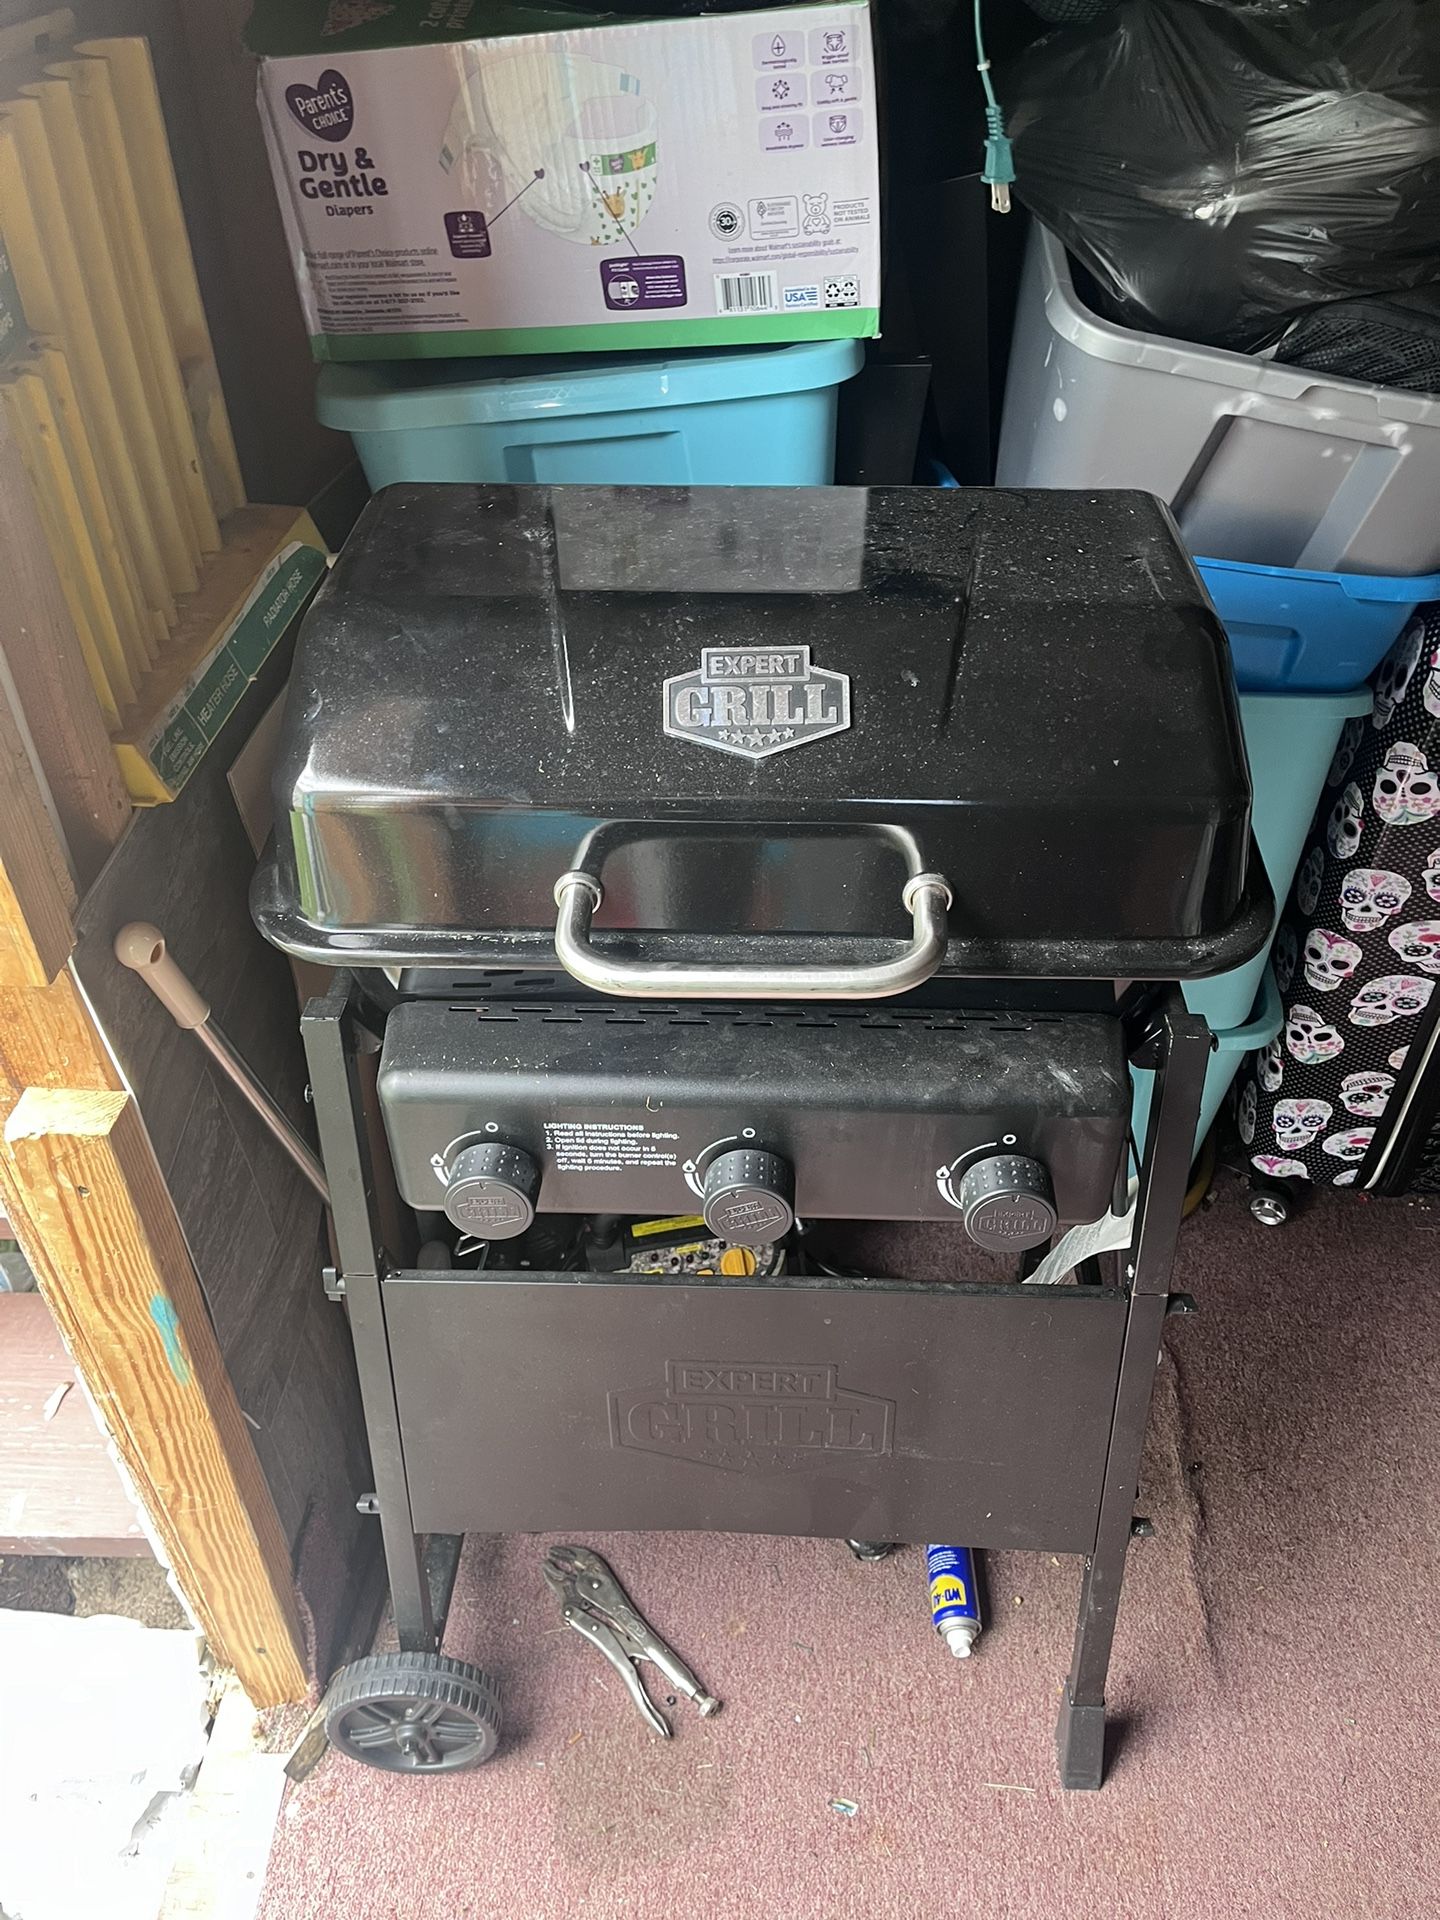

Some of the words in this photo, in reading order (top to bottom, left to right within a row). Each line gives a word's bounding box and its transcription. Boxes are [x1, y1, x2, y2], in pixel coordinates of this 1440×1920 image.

[295, 82, 348, 117] Parent's
[312, 108, 349, 129] CHOICE
[298, 150, 348, 177] Dry
[355, 147, 375, 169] &
[300, 173, 389, 199] Gentle
[325, 205, 373, 217] Diapers
[833, 202, 864, 210] PRODUCTS
[848, 207, 869, 215] TESTED
[719, 217, 732, 226] 30
[845, 213, 871, 222] ANIMALS
[785, 293, 807, 303] USA
[262, 588, 290, 628] RADIATOR
[285, 567, 305, 594] HOSE
[709, 654, 800, 675] EXPERT
[197, 685, 223, 727] HEATER
[221, 664, 239, 694] HOSE
[675, 683, 838, 727] GRILL
[543, 1122, 583, 1130] LIGHTING
[583, 1123, 644, 1131] INSTRUCTIONS
[554, 1137, 575, 1145] Open
[585, 1138, 609, 1146] during
[610, 1138, 638, 1146] lighting.
[651, 1132, 680, 1140] lighting.
[561, 1144, 588, 1152] ignition
[556, 1151, 589, 1159] seconds,
[642, 1152, 677, 1160] control(s)
[556, 1157, 570, 1165] off,
[593, 1158, 625, 1166] minutes,
[640, 1159, 664, 1167] repeat
[557, 1164, 583, 1172] lighting
[985, 1218, 1044, 1232] GRILL
[682, 1369, 823, 1393] EXPERT
[627, 1401, 875, 1451] GRILL
